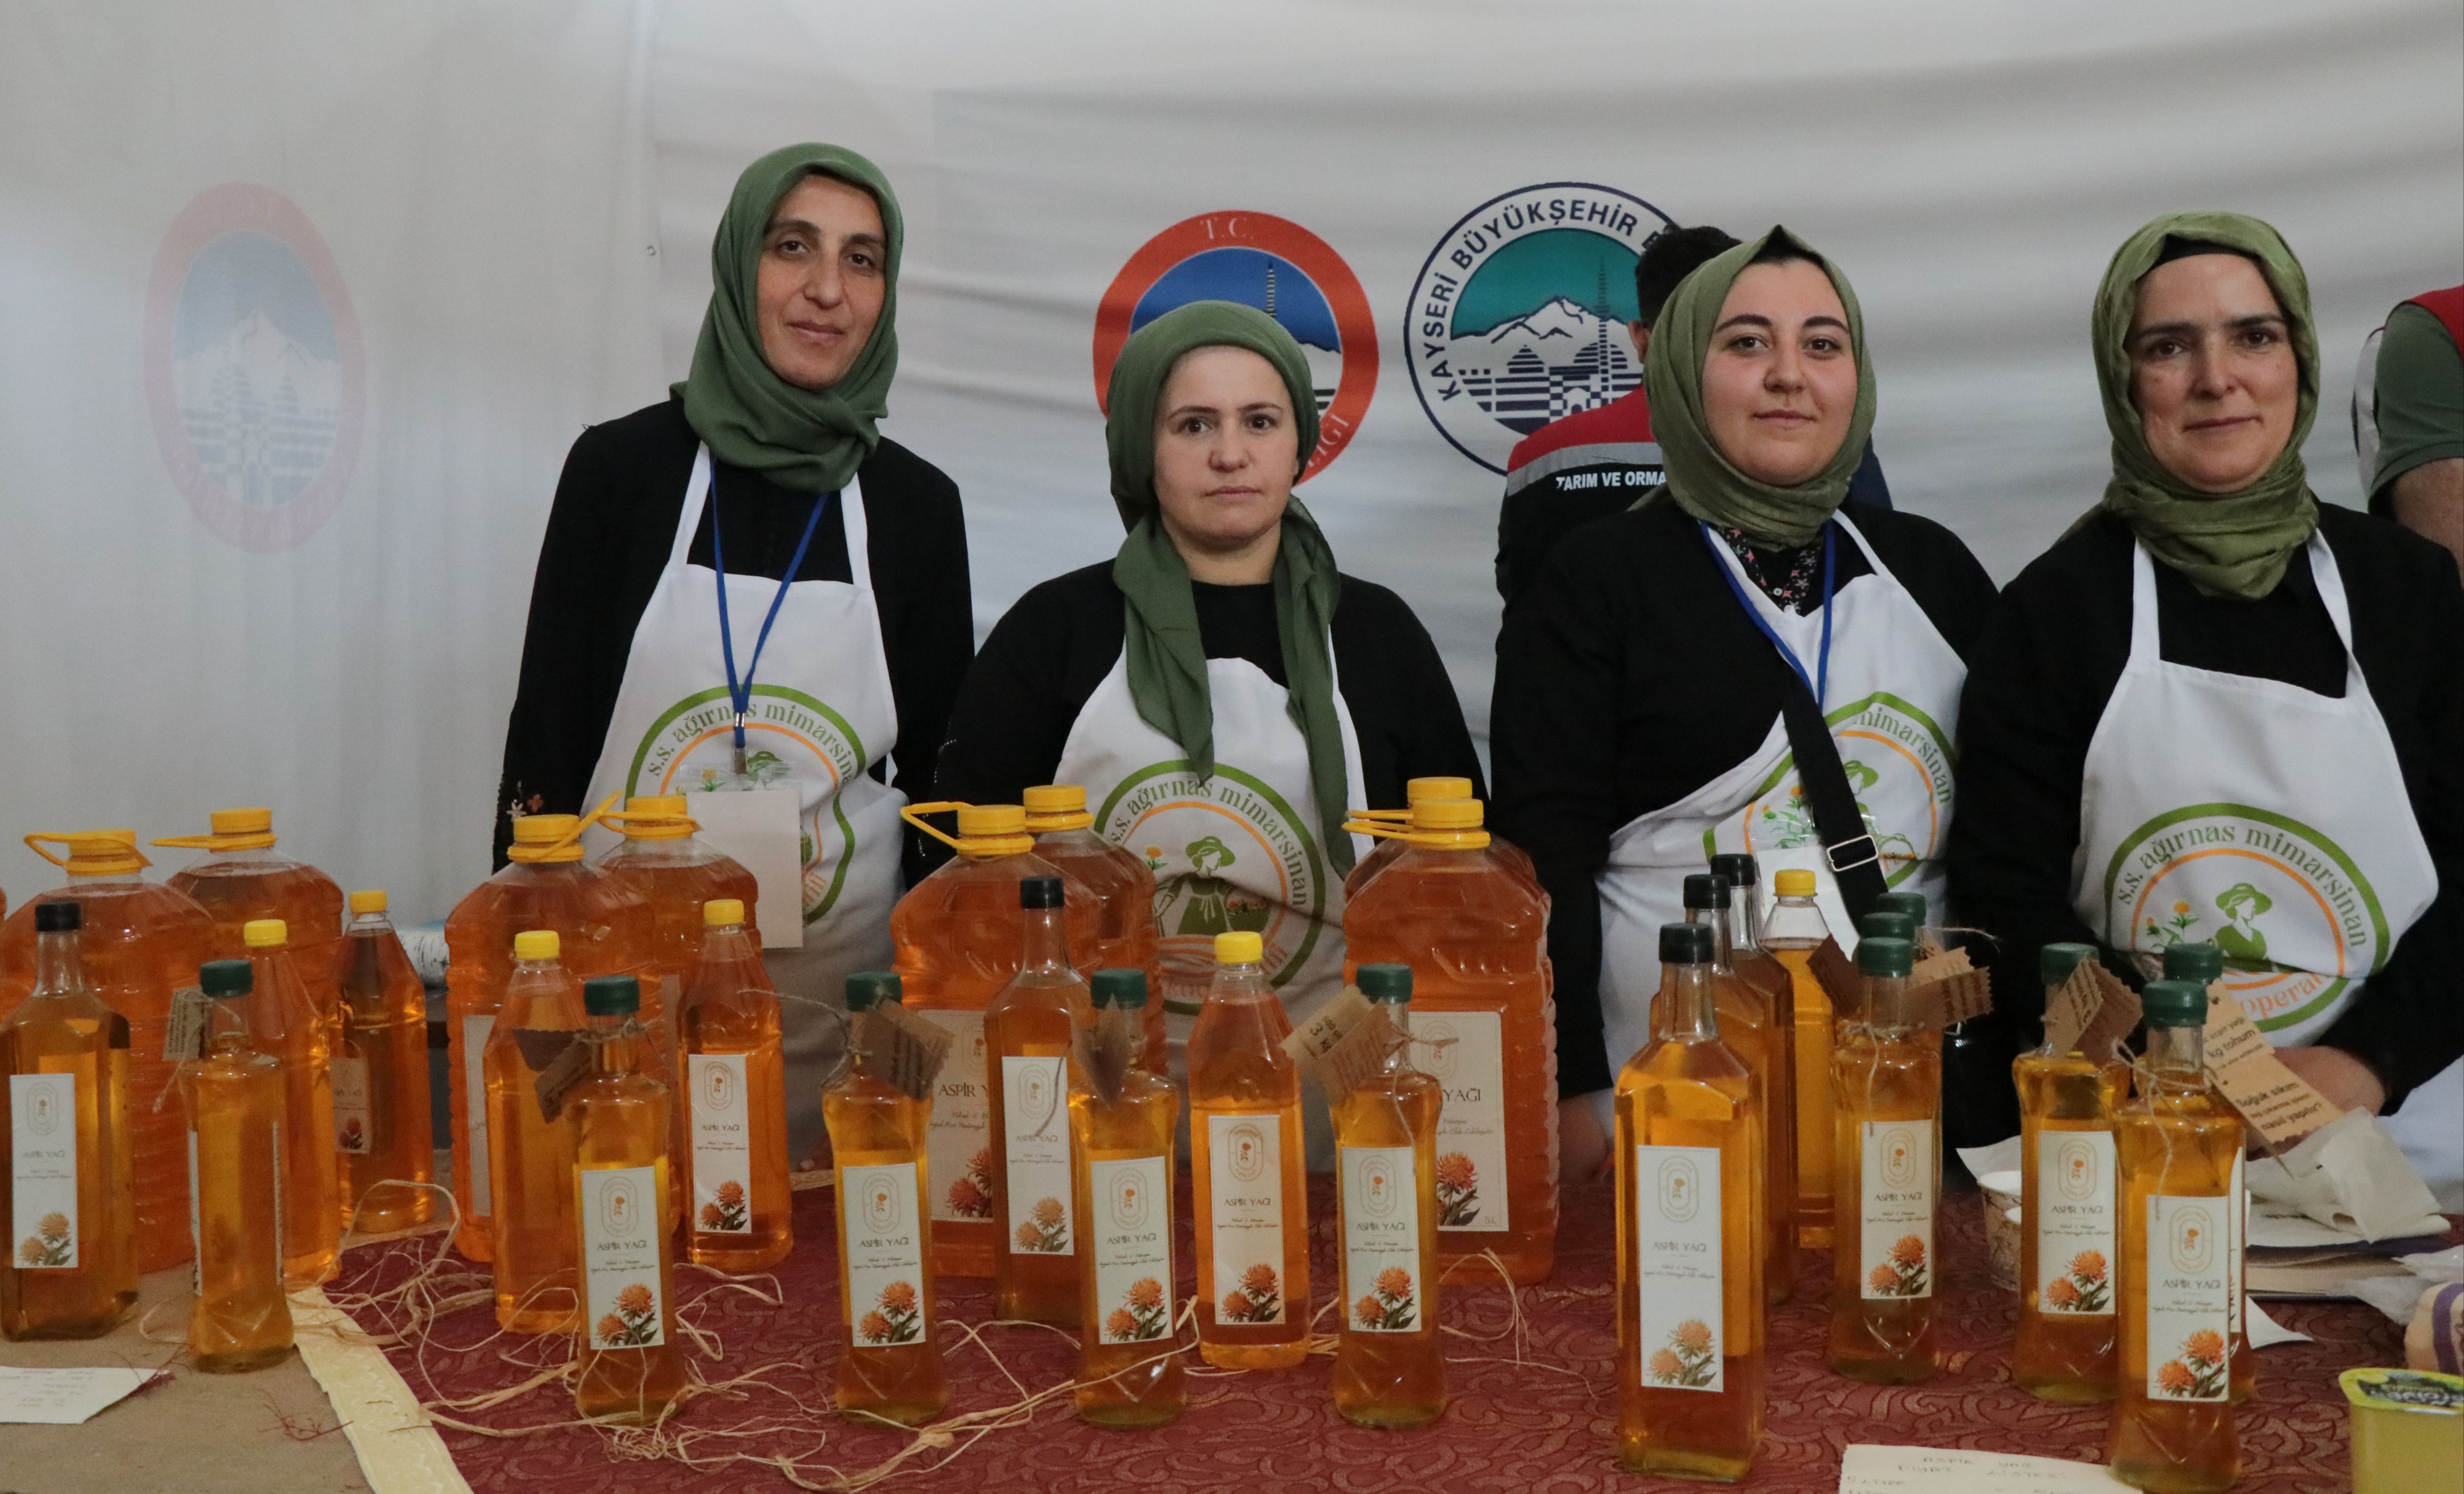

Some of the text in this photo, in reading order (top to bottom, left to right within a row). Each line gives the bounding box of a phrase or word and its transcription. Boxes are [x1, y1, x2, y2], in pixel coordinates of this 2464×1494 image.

[1423, 199, 1638, 400] KAYSERİ BÜYÜKŞEHİR
[1556, 471, 1666, 491] TARIM VE ORMA
[672, 703, 757, 743] ağırns
[764, 704, 852, 786] mimarsina
[1127, 780, 1214, 816] ağırnas
[1219, 785, 1307, 906] mimarsinan
[2139, 825, 2236, 871] ağırnas
[2245, 827, 2367, 947] mimarsinan
[2222, 1029, 2256, 1050] tohum
[938, 1082, 976, 1097] ASPİR
[1443, 1087, 1481, 1102] YAĞI
